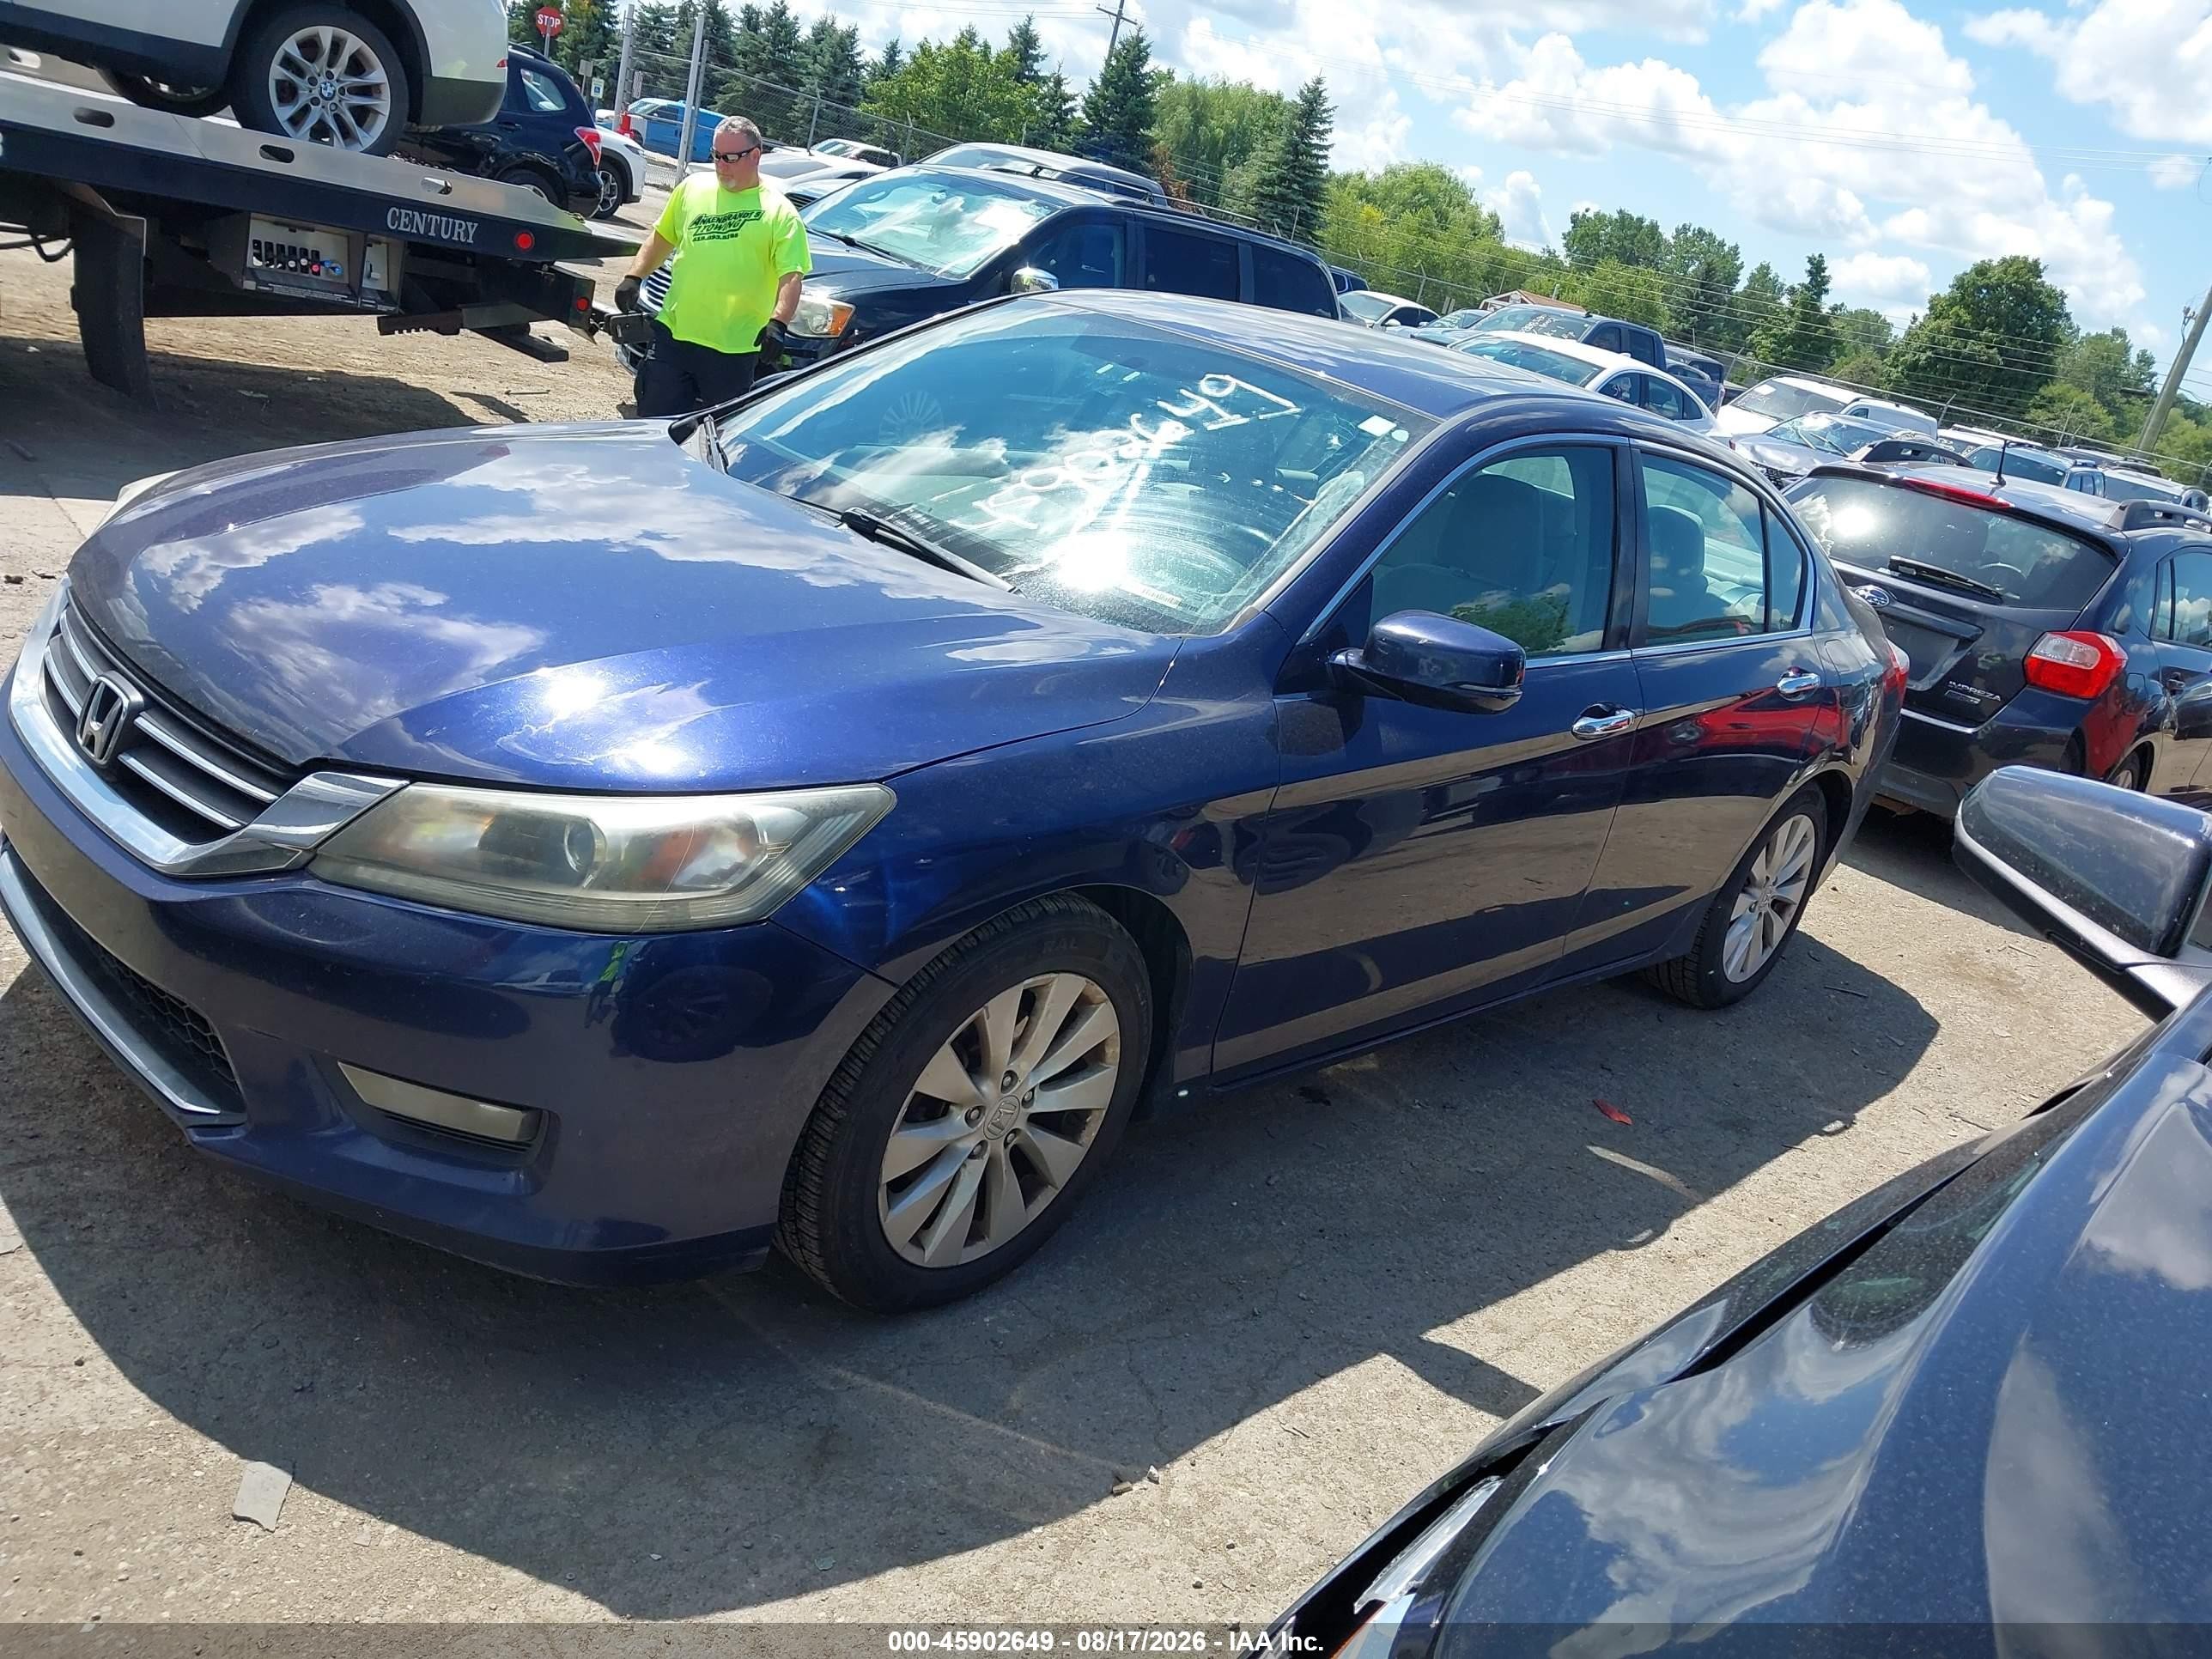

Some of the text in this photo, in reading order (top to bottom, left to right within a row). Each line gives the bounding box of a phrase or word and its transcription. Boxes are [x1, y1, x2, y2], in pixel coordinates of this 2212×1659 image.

[538, 14, 561, 28] STOP
[387, 207, 478, 244] CENTURY
[700, 219, 741, 233] TOWING
[1948, 681, 2002, 702] IMPREZA
